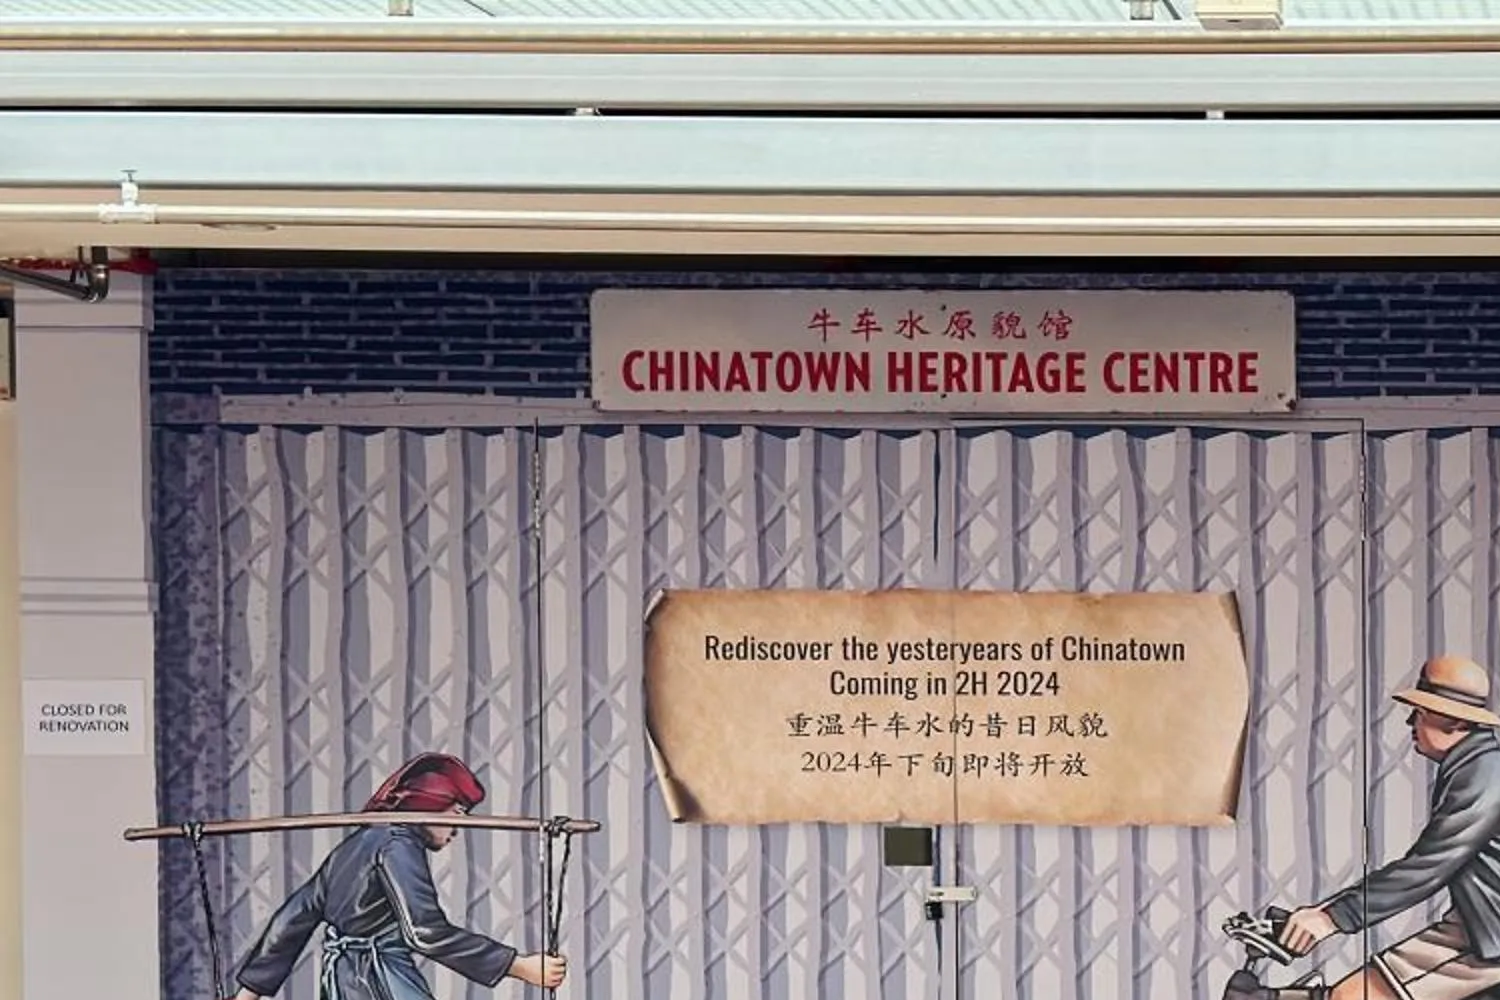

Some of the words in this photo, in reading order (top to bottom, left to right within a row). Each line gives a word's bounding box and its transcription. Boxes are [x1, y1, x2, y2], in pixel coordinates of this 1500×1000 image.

[808, 309, 1073, 344] 牛车水原貌馆
[620, 350, 871, 394] CHINATOWN
[886, 350, 1087, 394] HERITAGE
[1101, 350, 1259, 394] CENTRE
[705, 634, 833, 662] Rediscover
[841, 635, 879, 662] the
[886, 638, 1023, 670] yesteryears
[1030, 635, 1055, 662] of
[1061, 634, 1186, 662] Chinatown
[829, 670, 919, 702] Coming
[926, 670, 948, 697] in
[956, 670, 988, 697] 2H
[997, 670, 1061, 697] 2024
[40, 703, 95, 717] CLOSED
[99, 703, 128, 717] FOR
[785, 711, 1110, 740] 重温牛车水的昔日风貌
[38, 719, 130, 733] RENOVATION
[800, 750, 1091, 780] 2024年下旬即将开放
